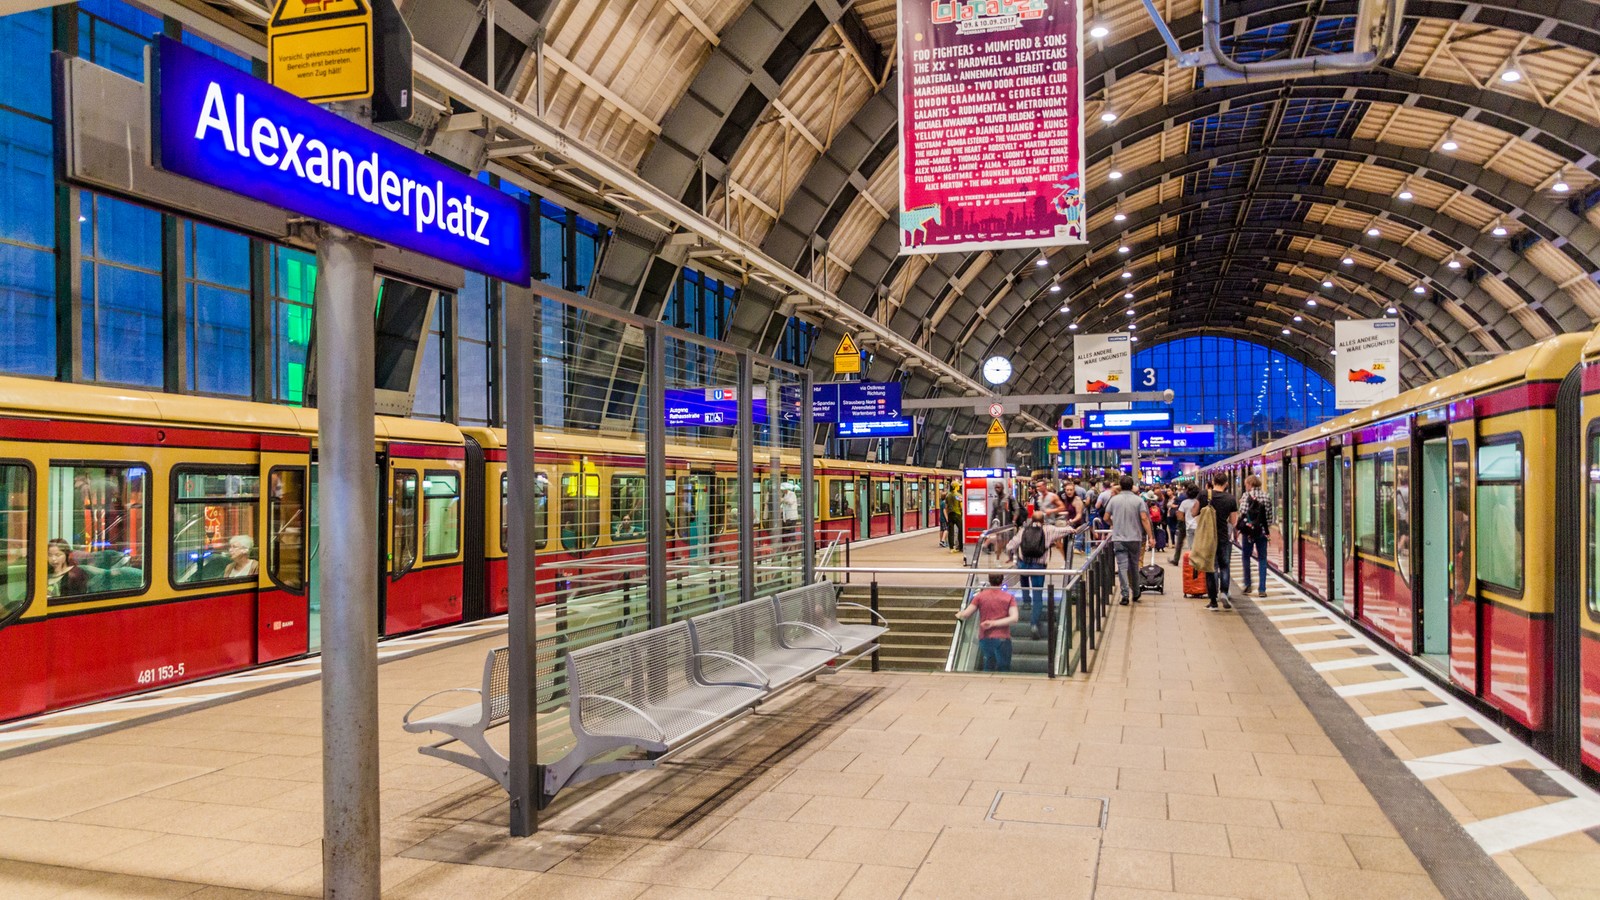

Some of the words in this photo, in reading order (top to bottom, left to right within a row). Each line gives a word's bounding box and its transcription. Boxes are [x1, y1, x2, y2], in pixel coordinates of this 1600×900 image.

[980, 17, 1015, 26] 10.09.2017
[305, 46, 361, 60] gekennzeichneten
[914, 49, 930, 61] FOO
[932, 44, 974, 59] FIGHTERS
[984, 38, 1032, 54] MUMFORD
[1034, 36, 1042, 48] &
[1044, 34, 1067, 47] SONS
[914, 63, 930, 74] THE
[932, 61, 946, 72] XX
[958, 54, 1003, 69] HARDWELL
[1015, 48, 1067, 63] BEATSTEAKS
[315, 70, 326, 78] Zug
[914, 73, 952, 86] MARTERIA
[960, 63, 1044, 80] ANNENMAYKANTEREIT
[1052, 61, 1068, 71] CRO
[914, 83, 965, 97] MARSHMELLO
[974, 80, 992, 91] TWO
[994, 79, 1014, 89] DOOR
[1016, 75, 1046, 87] CINEMA
[1049, 73, 1067, 84] CLUB
[914, 96, 948, 108] LONDON
[950, 92, 996, 104] GRAMMAR
[1008, 87, 1042, 100] GEORGE
[1044, 85, 1068, 96] EZRA
[914, 108, 950, 120] GALANTIS
[958, 102, 1006, 115] RUDIMENTAL
[1016, 97, 1068, 110] METRONOMY
[914, 120, 942, 130] MICHAEL
[942, 116, 978, 128] KIWANUKA
[984, 114, 1006, 124] OLIVER
[1008, 111, 1035, 122] HELDENS
[1042, 108, 1068, 118] WANDA
[914, 130, 944, 140] YELLOW
[946, 128, 966, 138] CLAW
[976, 124, 1004, 135] DJANGO
[1006, 122, 1034, 133] DJANGO
[1044, 119, 1068, 129] KUNGS
[914, 140, 942, 150] WESTBAM
[947, 138, 966, 147] BOMBA
[1006, 132, 1032, 141] VACCINES
[1038, 130, 1056, 138] BEAR'S
[915, 150, 925, 158] THE
[988, 142, 1017, 151] ROOSEVELT
[1024, 140, 1046, 148] MARTIN
[1048, 138, 1068, 146] JENSEN
[194, 80, 490, 247] Alexanderplatz
[915, 156, 950, 166] ANNE-MARIE
[958, 154, 980, 162] THOMAS
[1032, 148, 1049, 156] CRACK
[915, 167, 930, 175] ALEX
[930, 164, 952, 173] VARGAS
[1008, 159, 1026, 167] SIGRID
[1033, 157, 1048, 165] MIKE
[1050, 156, 1068, 164] PERRY
[915, 175, 934, 183] FILOUS
[944, 172, 972, 180] NGHTMRE
[982, 168, 1010, 178] DRUNKEN
[1012, 166, 1040, 175] MASTERS
[1049, 164, 1068, 172] BETSY
[940, 181, 963, 189] MERTON
[1040, 174, 1058, 182] MEUTE
[1339, 340, 1356, 348] ALLES
[1357, 334, 1378, 344] ANDERE
[1093, 348, 1112, 356] ANDERE
[1142, 368, 1156, 386] 3
[715, 390, 722, 400] U
[138, 668, 155, 684] 481
[158, 662, 185, 681] 153-5
